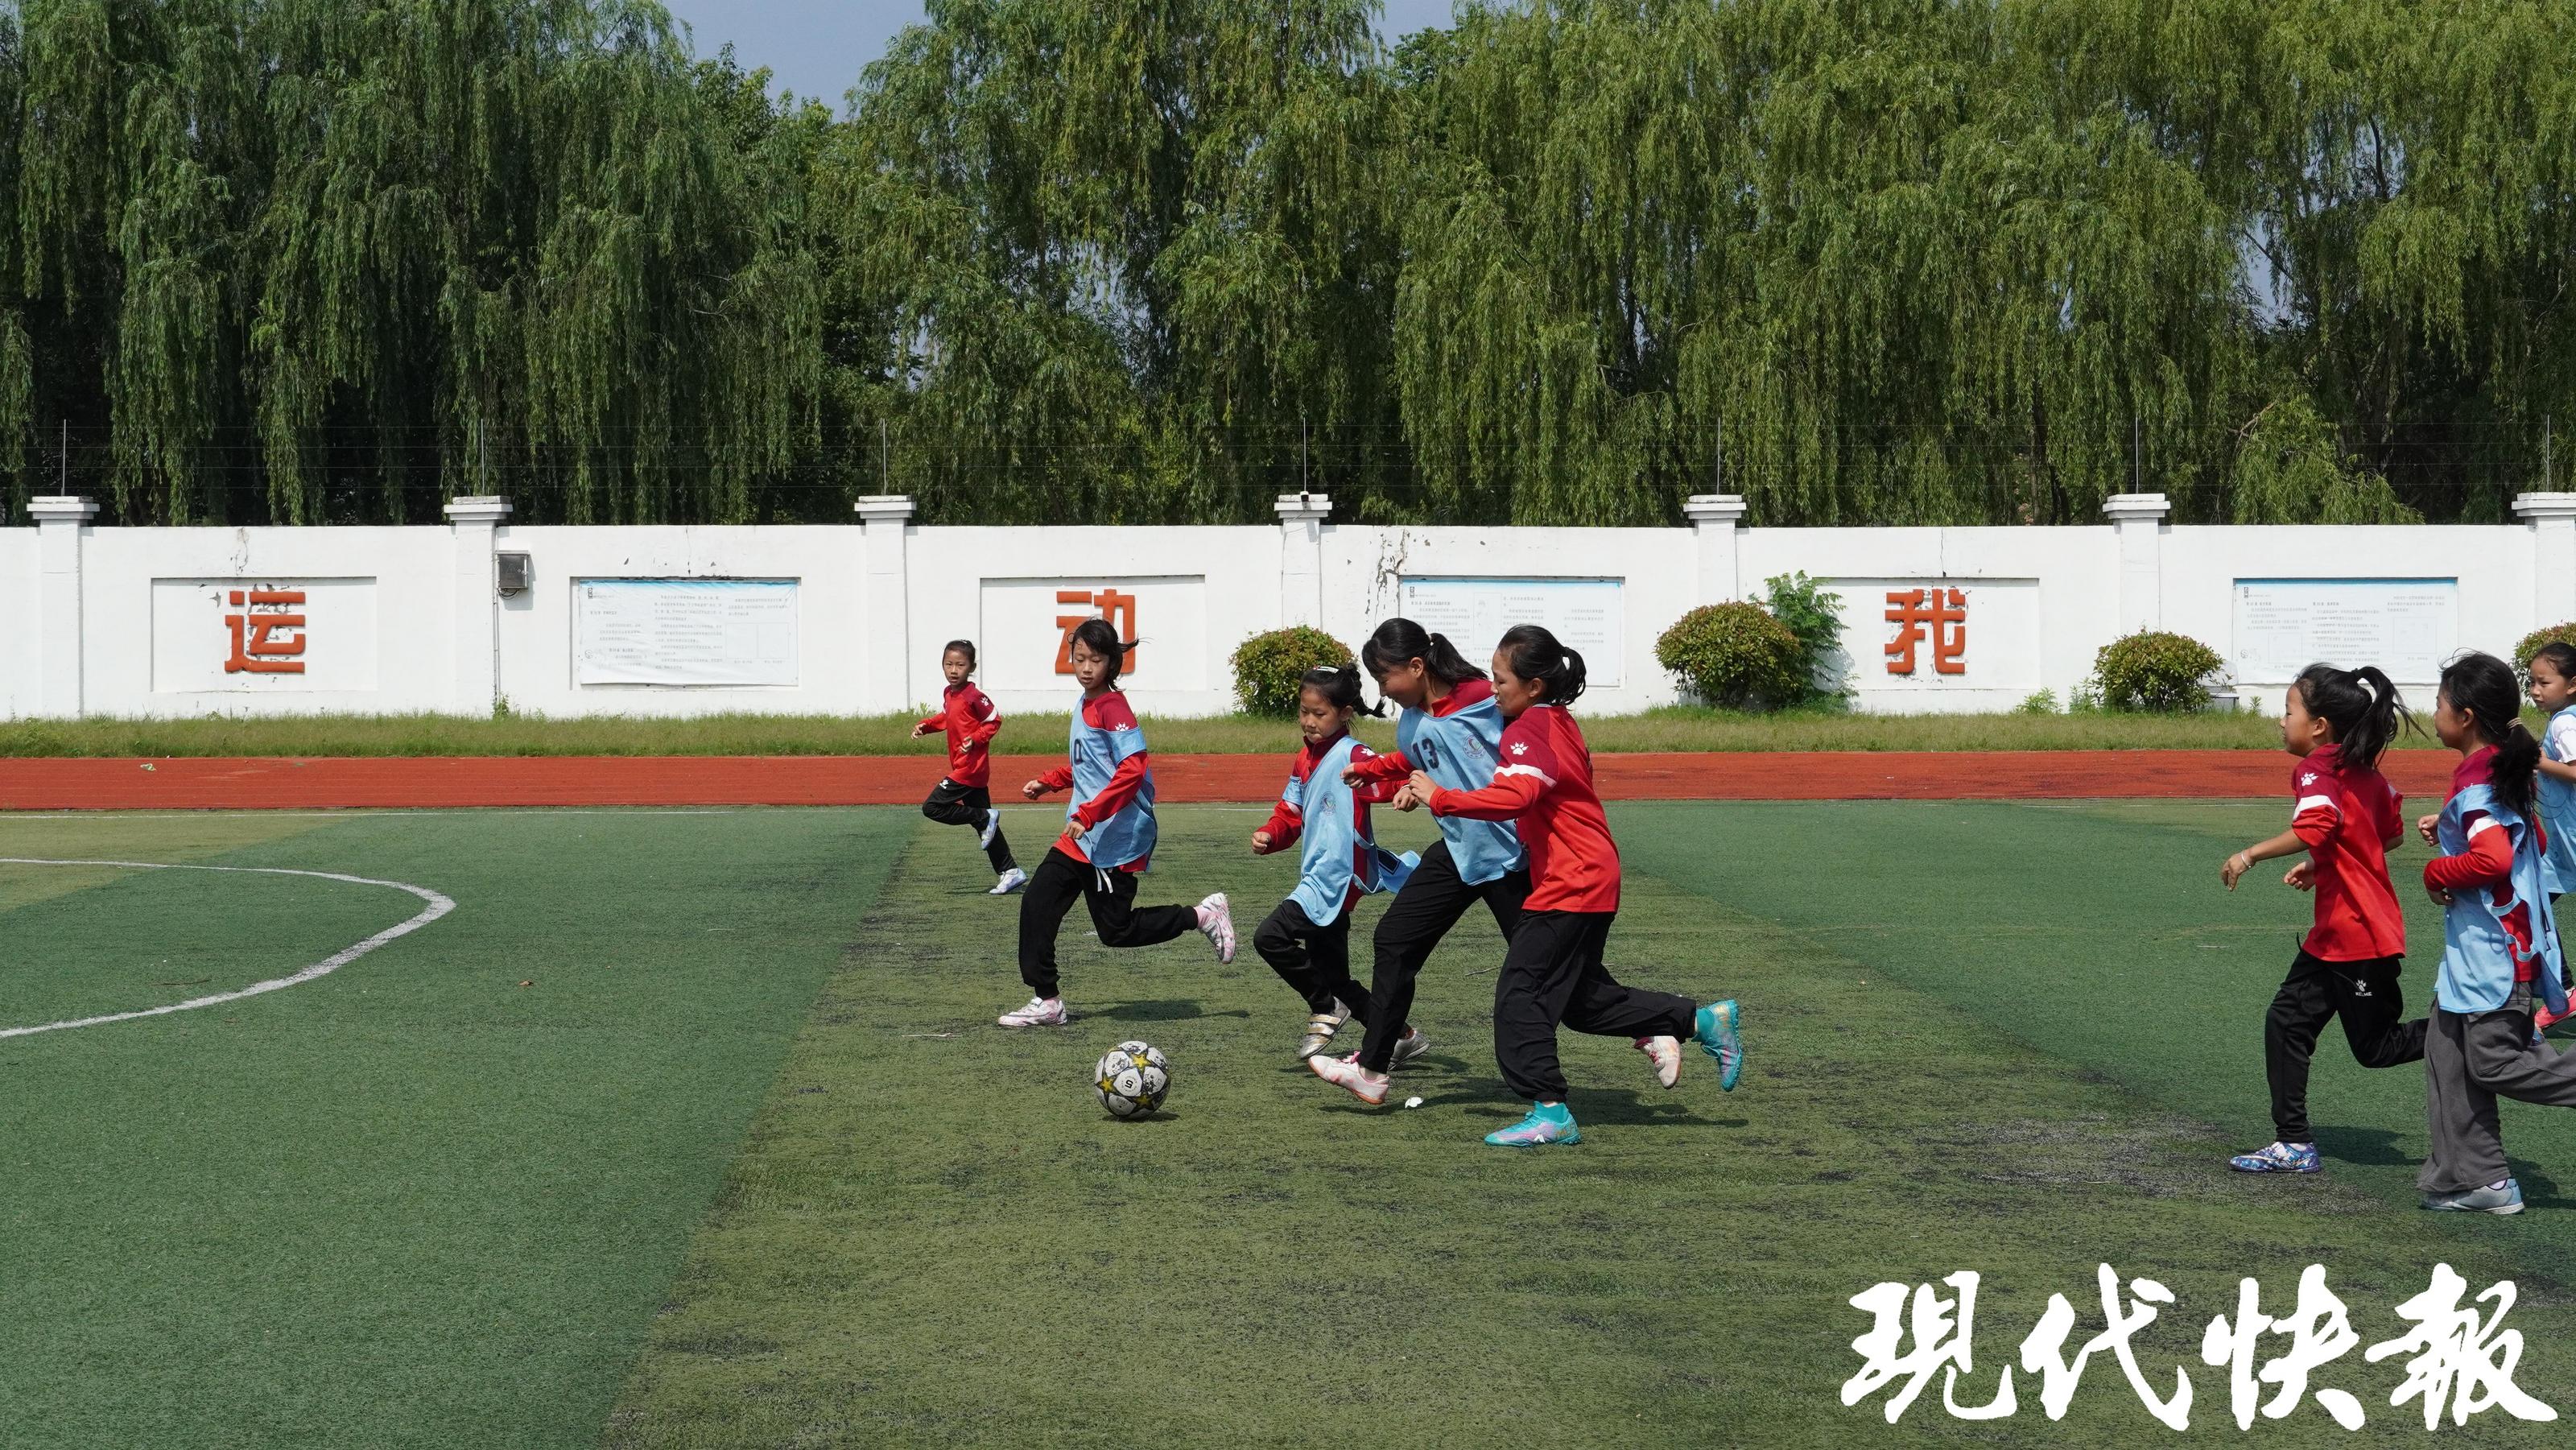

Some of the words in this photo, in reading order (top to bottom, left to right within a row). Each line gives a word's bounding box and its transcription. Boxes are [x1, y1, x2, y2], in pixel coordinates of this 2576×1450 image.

[225, 590, 306, 674] 运
[1055, 589, 1135, 674] 动
[1885, 589, 1966, 674] 我
[1412, 737, 1440, 773] 13
